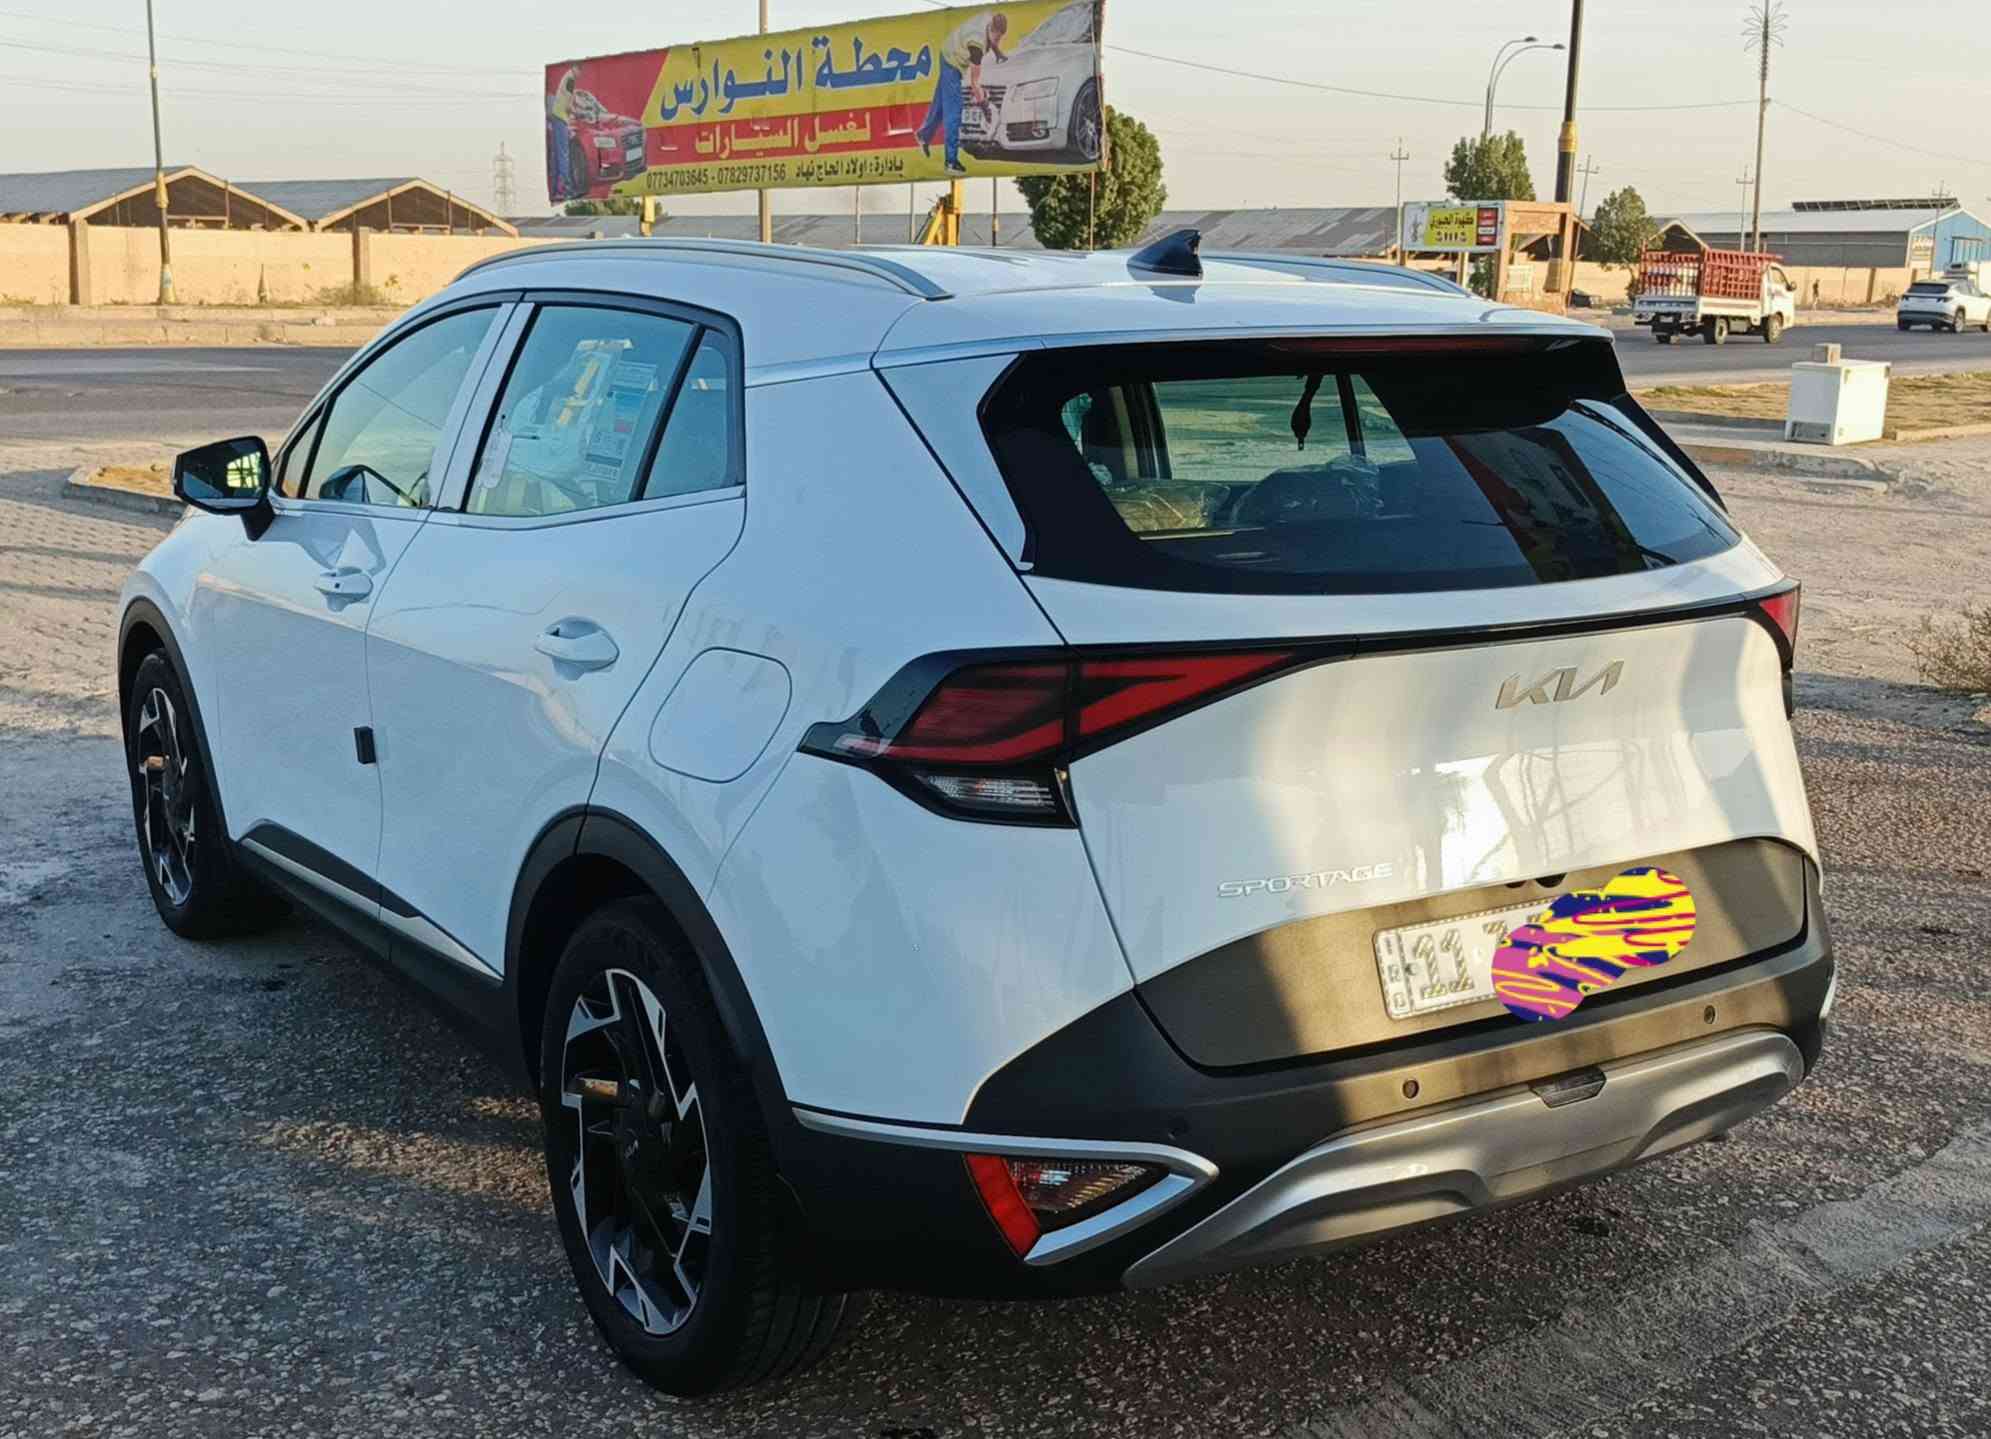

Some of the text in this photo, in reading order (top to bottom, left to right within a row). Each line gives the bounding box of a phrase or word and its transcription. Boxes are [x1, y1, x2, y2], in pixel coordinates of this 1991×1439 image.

[660, 35, 932, 121] محطة النوارس
[805, 112, 871, 152] لغسل
[1494, 658, 1625, 710] KIA
[1217, 862, 1394, 899] SPORTAGE
